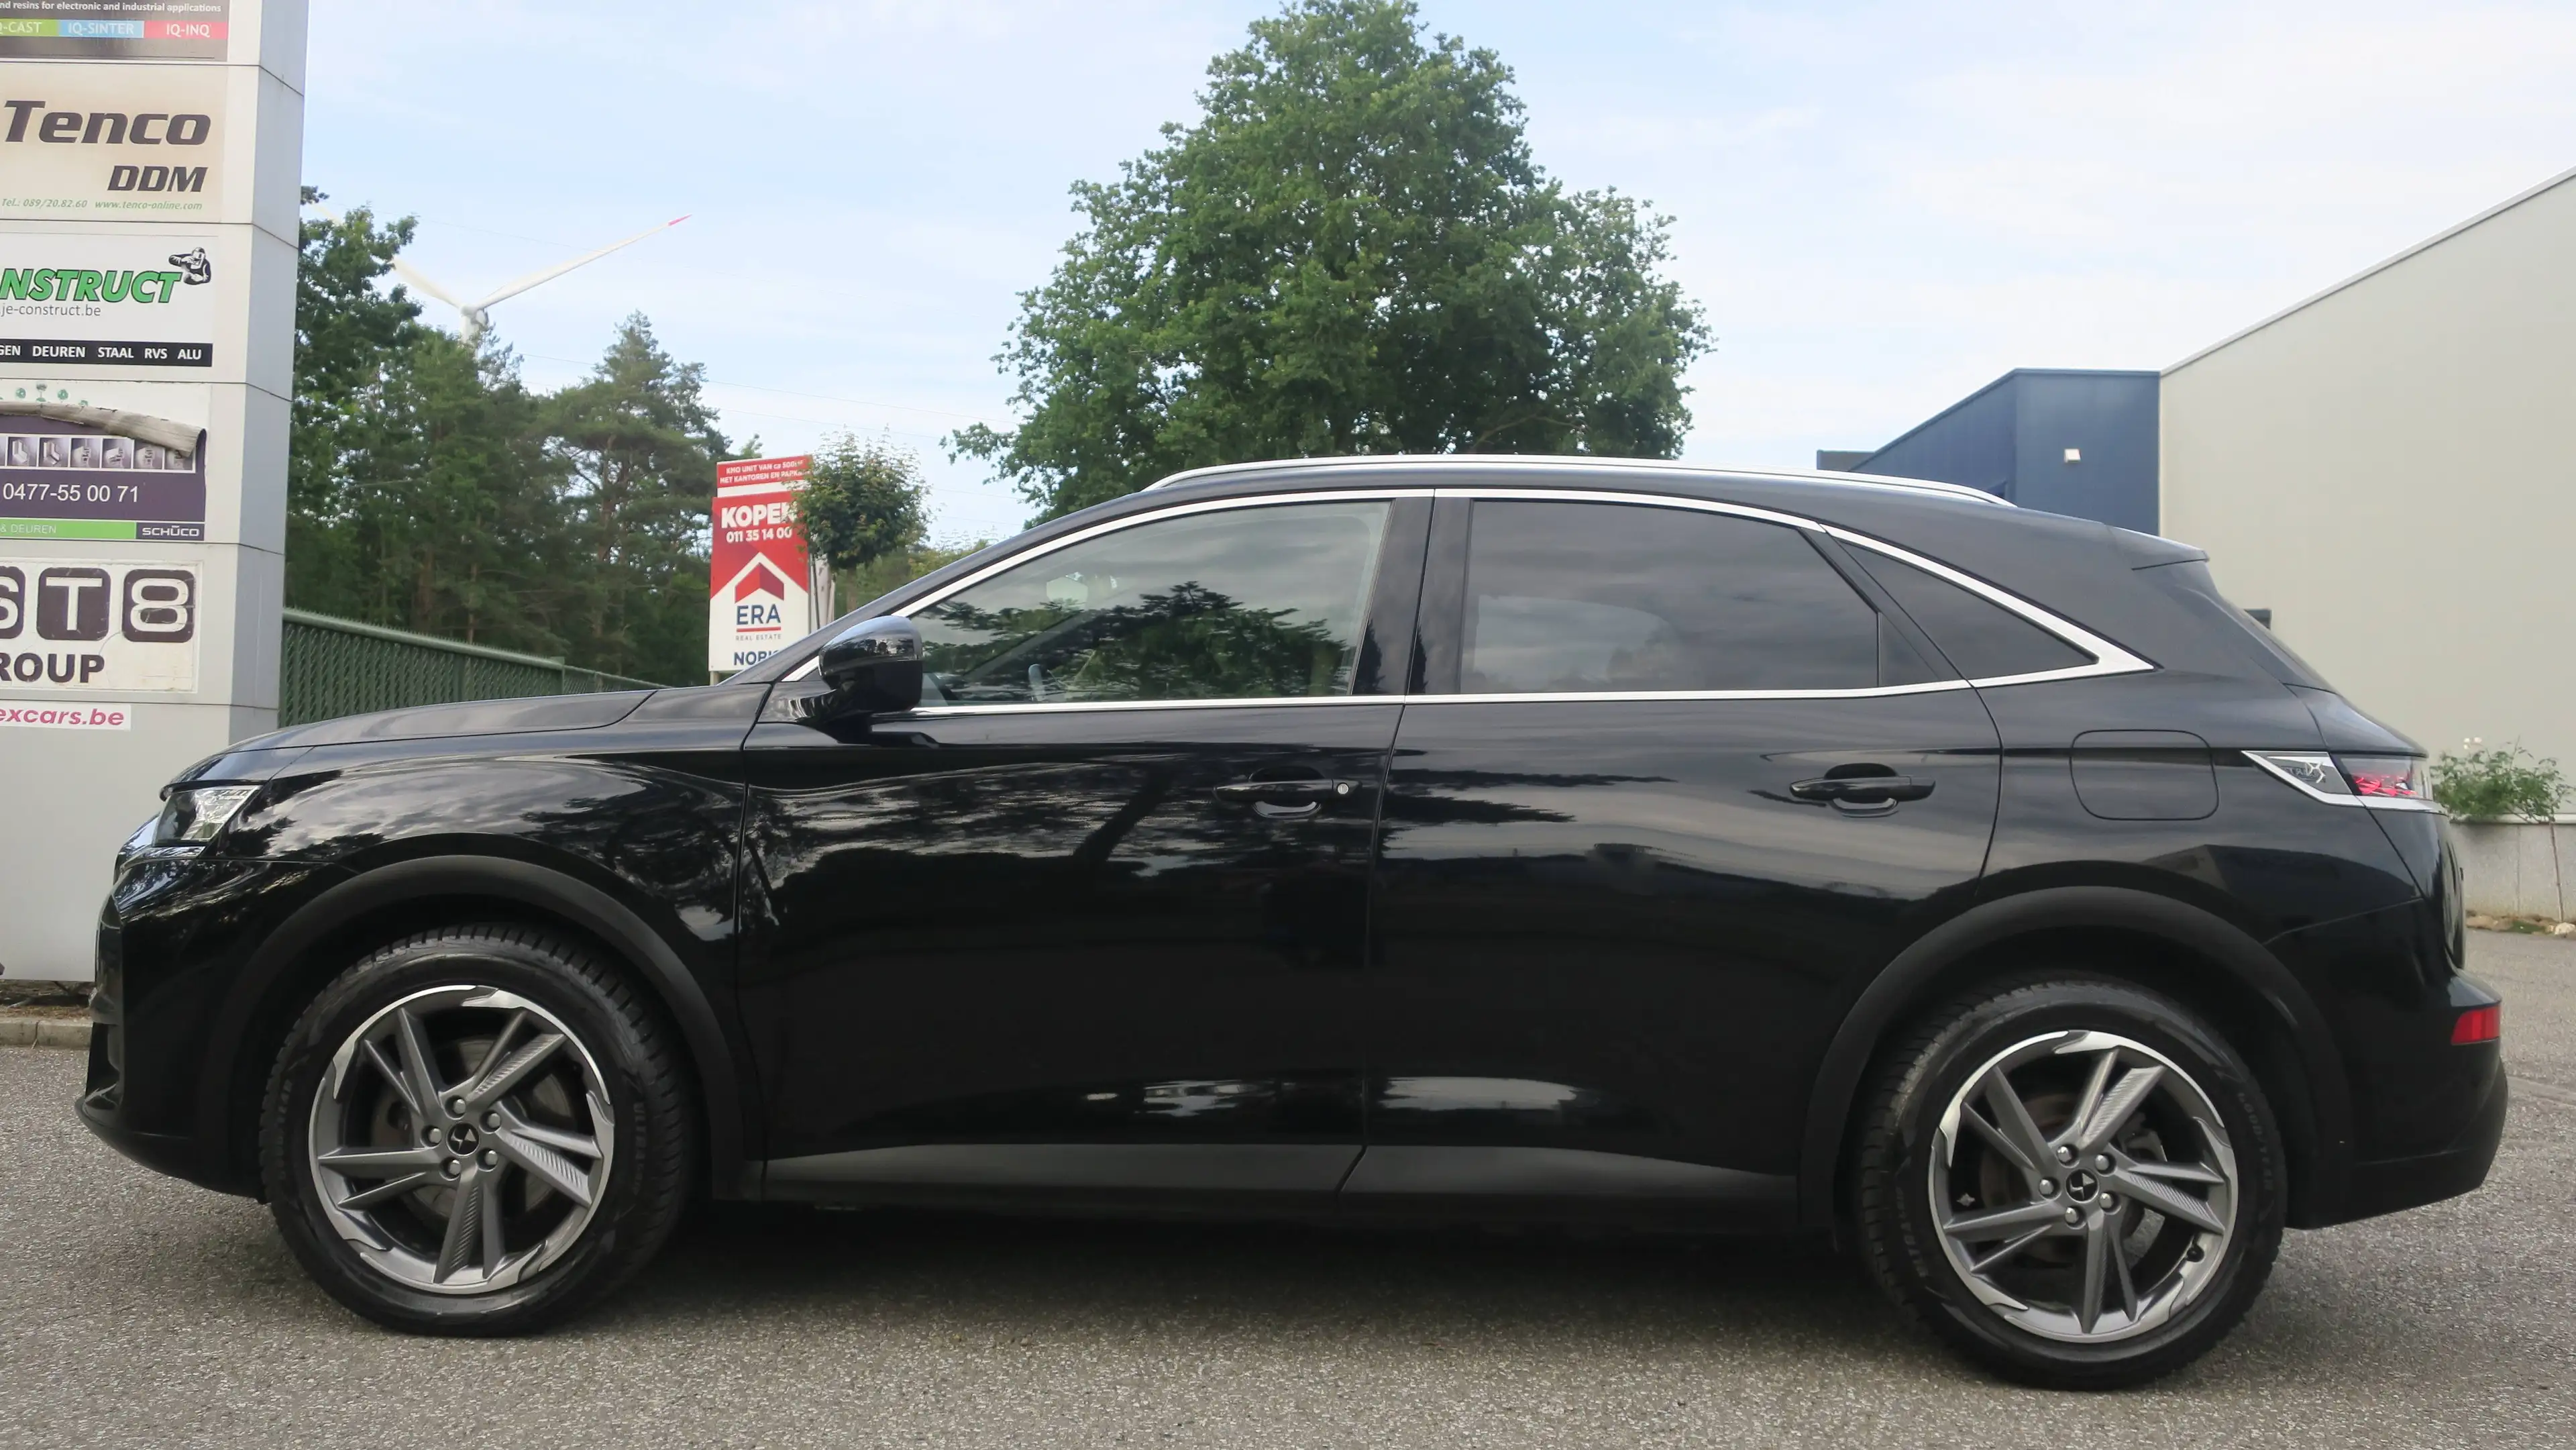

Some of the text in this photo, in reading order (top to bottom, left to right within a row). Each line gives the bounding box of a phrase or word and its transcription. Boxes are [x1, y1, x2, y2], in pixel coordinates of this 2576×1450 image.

[42, 1, 56, 9] for
[56, 2, 101, 10] electronic
[122, 3, 164, 11] industrial
[166, 3, 221, 13] applications
[68, 22, 134, 36] IQ-SINTER
[166, 23, 210, 38] IQ-INQ
[5, 100, 211, 145] Tenco
[107, 165, 208, 193] DDM
[23, 199, 88, 209] 089/20.82.60
[95, 201, 203, 210] www.tenco-online.com
[32, 346, 86, 358] DEUREN
[97, 347, 134, 358] STAAL
[144, 348, 168, 359] RVS
[177, 349, 202, 360] ALU
[741, 464, 757, 472] UNIT
[758, 463, 773, 471] VAN
[733, 472, 769, 482] KANTOREN
[770, 471, 780, 479] EN
[3, 482, 139, 503] 0477-55 00 71
[11, 523, 56, 534] DEUREN
[142, 525, 200, 537] SCHÜCO
[726, 526, 792, 543] 011 35 14 00
[736, 603, 781, 625] ERA
